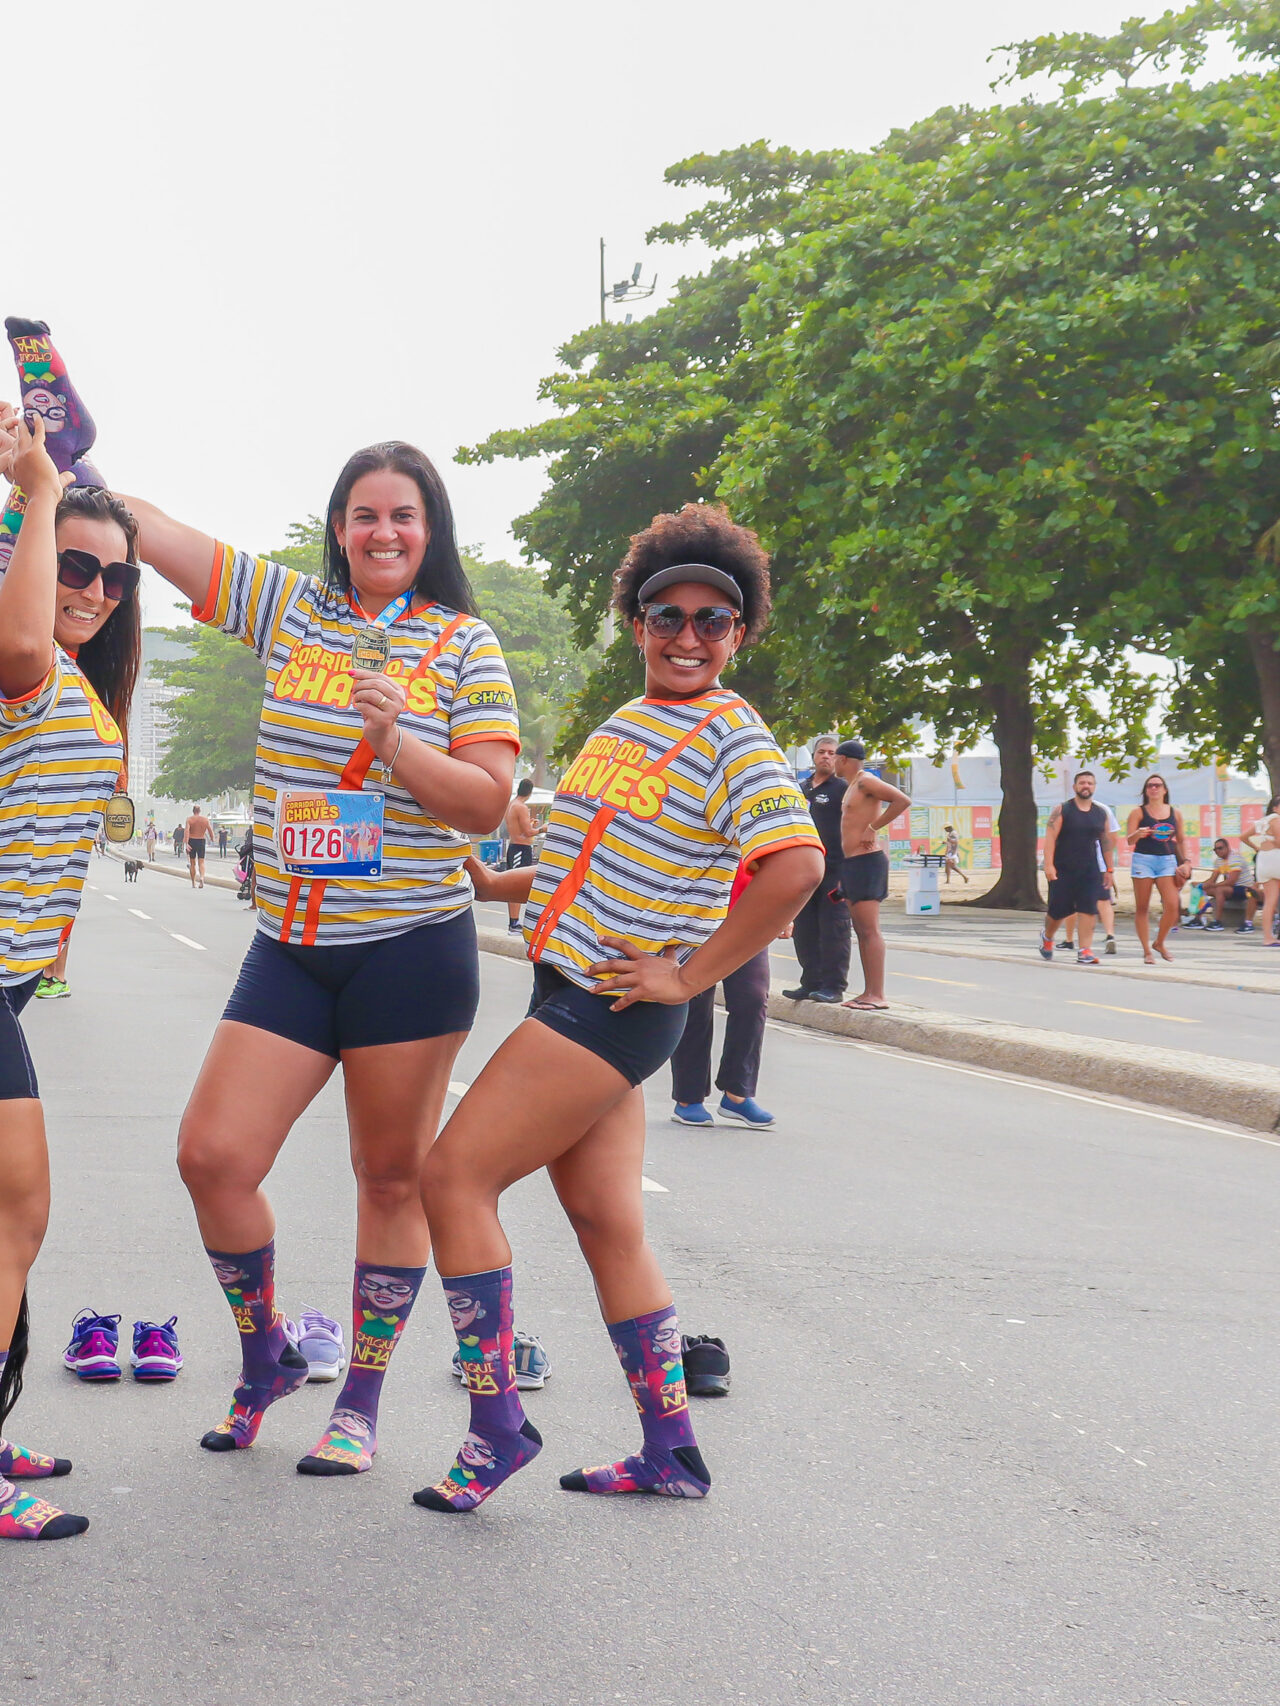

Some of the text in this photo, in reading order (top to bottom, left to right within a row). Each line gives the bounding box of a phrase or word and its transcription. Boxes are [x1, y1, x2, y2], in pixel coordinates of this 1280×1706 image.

[15, 337, 50, 353] NHA
[291, 641, 354, 673] CORRID
[275, 662, 438, 715] CHAS
[468, 690, 518, 709] CHAV
[615, 741, 645, 765] DO
[556, 755, 667, 817] HAVES
[286, 799, 327, 809] CORRIDA DO
[286, 805, 340, 822] CHAVES
[282, 827, 342, 858] 0126
[232, 1305, 254, 1316] QUI
[355, 1331, 396, 1350] CHIQUI
[354, 1343, 391, 1367] NHA
[463, 1362, 496, 1374] IQUI
[467, 1373, 500, 1393] HA
[662, 1391, 688, 1409] NH
[23, 1506, 64, 1528] NHA
